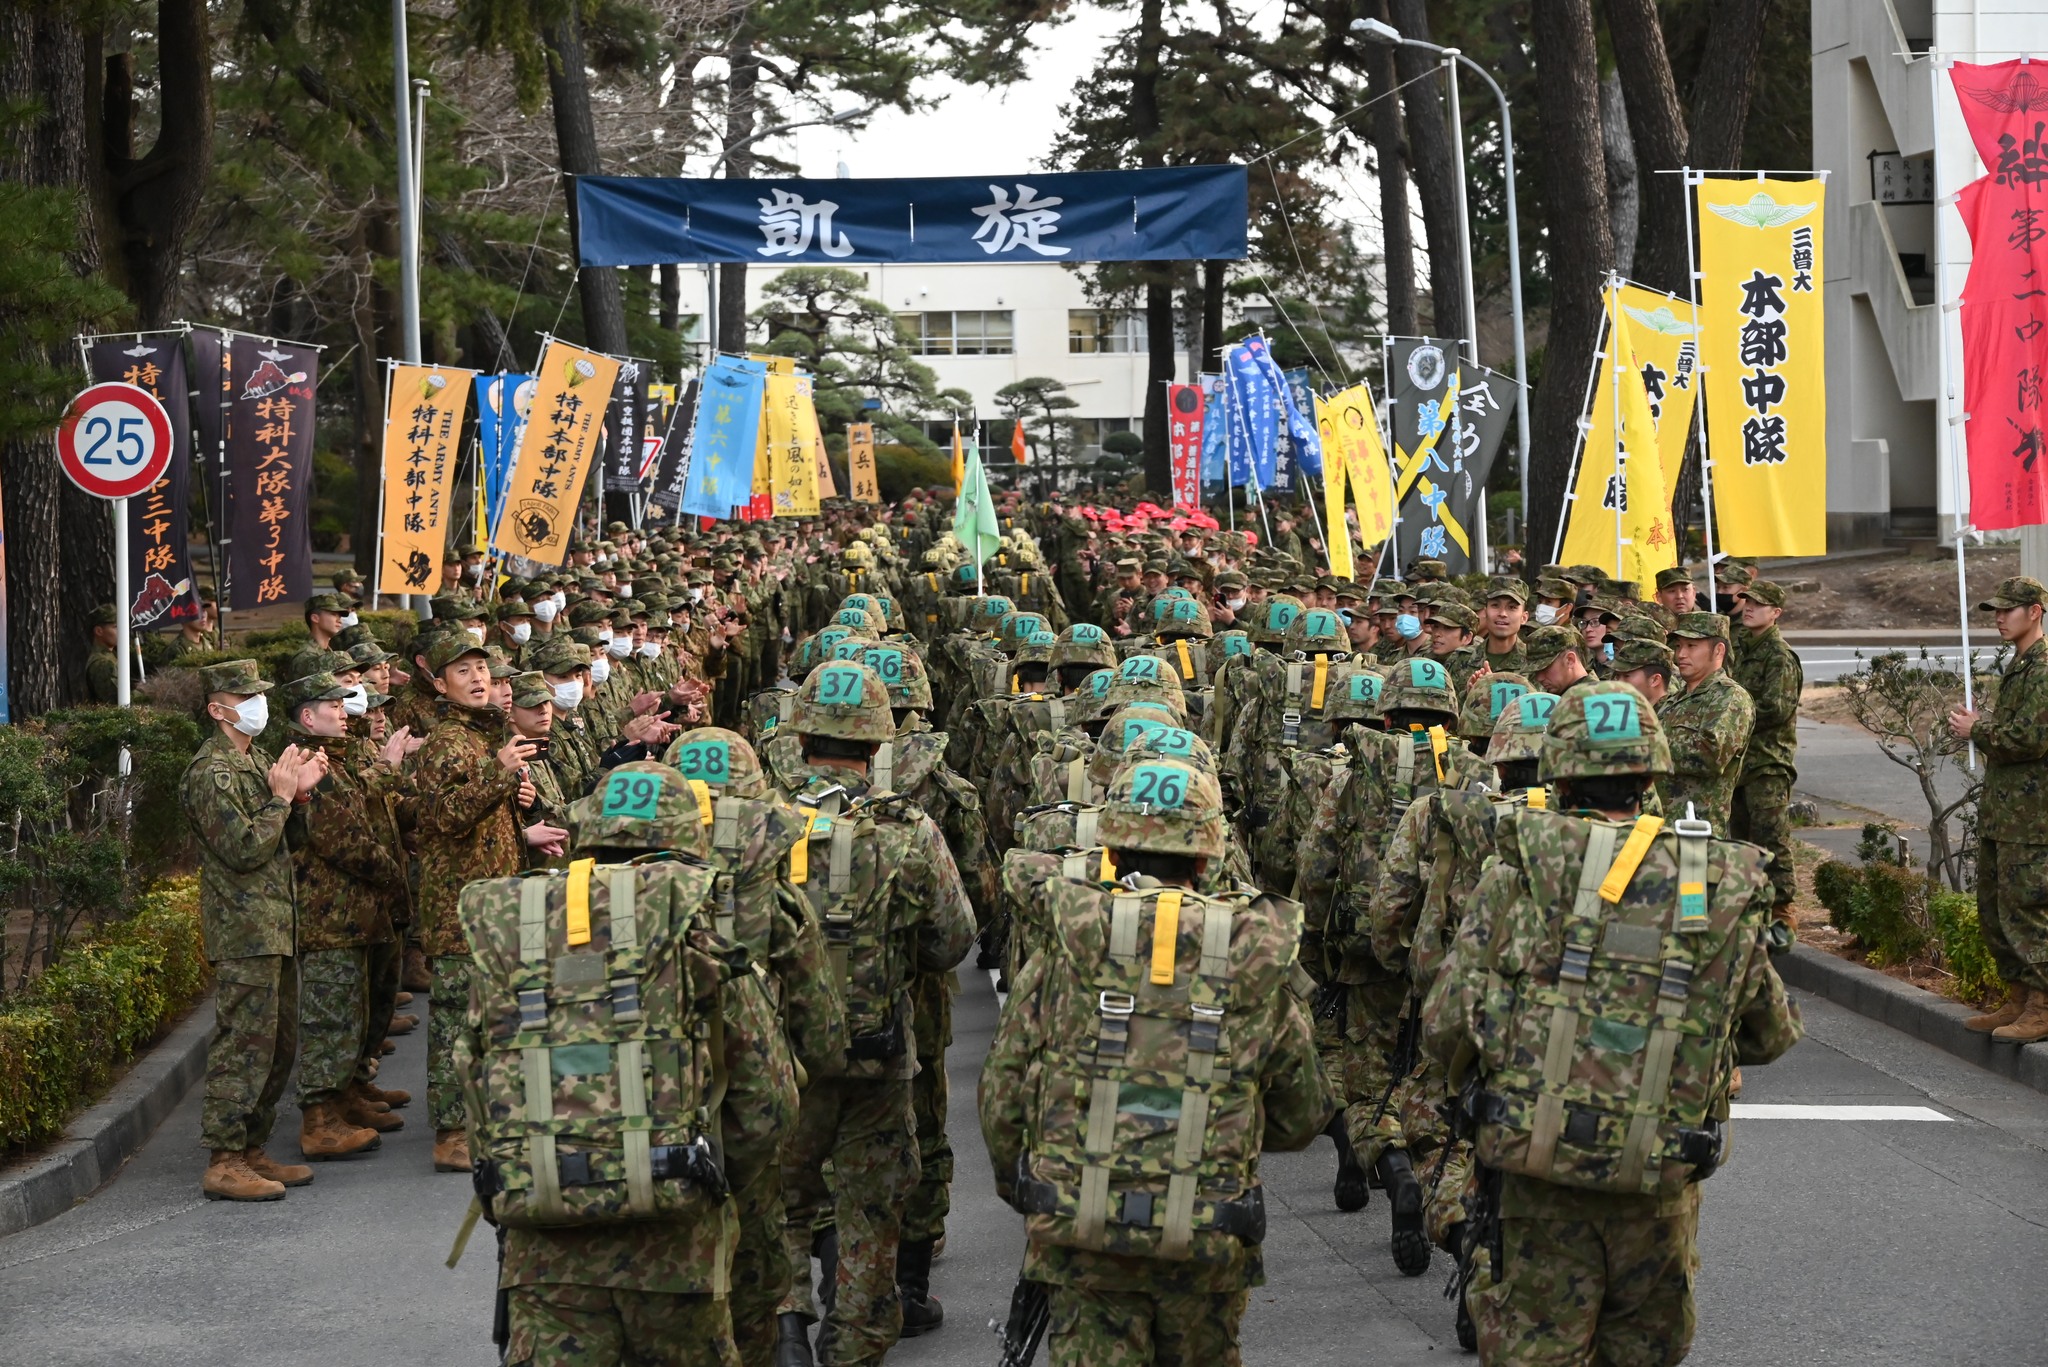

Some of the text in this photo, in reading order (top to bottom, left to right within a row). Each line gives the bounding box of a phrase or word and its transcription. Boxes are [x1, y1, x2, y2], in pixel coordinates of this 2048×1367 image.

[757, 184, 1071, 256] 凱旋
[1791, 226, 1814, 293] 三普大
[1739, 270, 1789, 466] 本部中隊
[83, 416, 144, 466] 25
[532, 391, 584, 500] 特科本部中隊
[564, 411, 593, 491] THE ARMY ANTS
[403, 403, 438, 533] 特科本部中隊
[428, 408, 454, 528] THE ARMY ANTS
[1416, 398, 1450, 558] 第八中隊
[255, 397, 296, 604] 特科大隊第3中隊
[964, 567, 971, 578] 1
[842, 612, 862, 625] 30
[990, 601, 1005, 614] 15
[1180, 602, 1190, 615] 4
[1278, 607, 1290, 624] 6
[1019, 619, 1036, 634] 17
[1076, 624, 1099, 639] 20
[1315, 615, 1327, 634] 7
[1233, 639, 1242, 654] 5
[868, 653, 899, 678] 36
[1125, 659, 1155, 678] 22
[1422, 662, 1436, 681] 9
[823, 671, 859, 698] 37
[1361, 678, 1374, 697] 8
[1526, 697, 1555, 719] 12
[1591, 700, 1631, 734] 27
[1152, 728, 1187, 750] 25
[685, 746, 724, 775] 38
[607, 777, 655, 810] 39
[1135, 771, 1181, 807] 26
